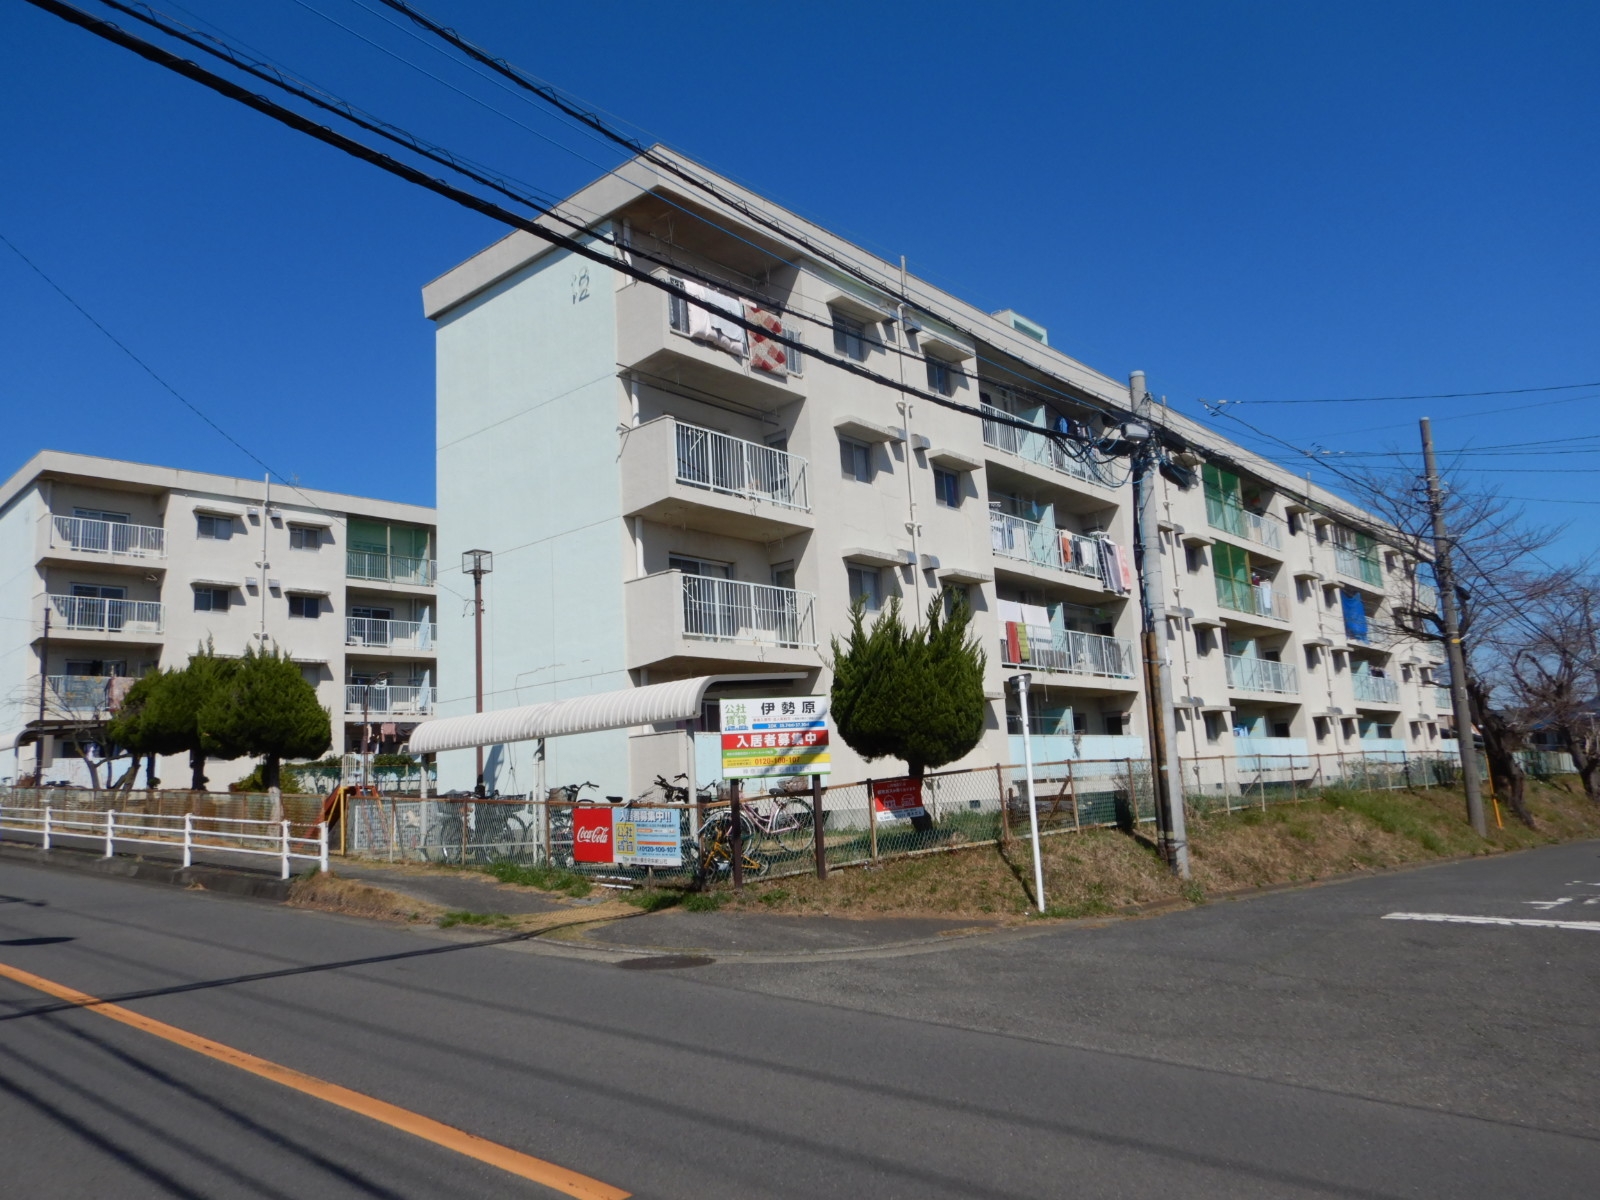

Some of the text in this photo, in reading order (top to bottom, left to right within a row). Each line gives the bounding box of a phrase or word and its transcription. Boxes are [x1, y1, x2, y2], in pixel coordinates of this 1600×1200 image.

[724, 703, 747, 714] 公社
[760, 700, 816, 715] 伊勢原
[736, 732, 817, 748] 入居者募集中
